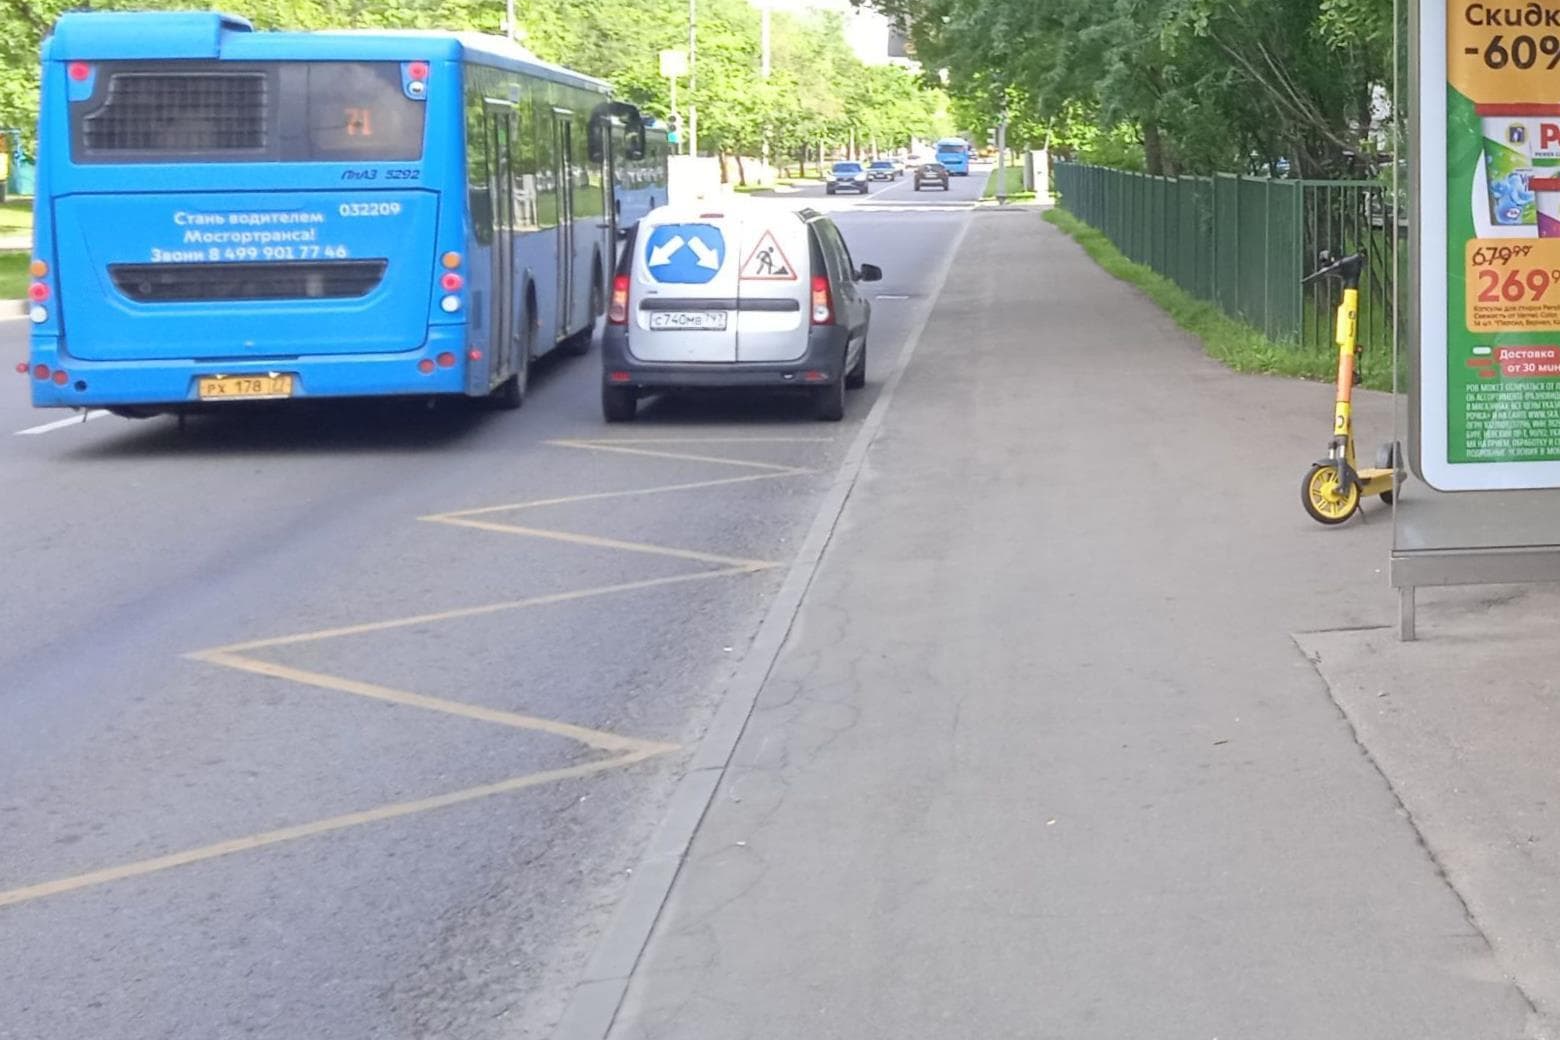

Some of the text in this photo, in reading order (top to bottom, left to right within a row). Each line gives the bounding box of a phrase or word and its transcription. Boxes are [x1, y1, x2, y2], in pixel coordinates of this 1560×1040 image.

[384, 169, 420, 180] 5292
[340, 202, 401, 217] 032209
[174, 211, 325, 227] Стань водителем
[183, 228, 316, 244] Мосгортранса!
[151, 245, 347, 261] Звони 8 499 901 77 46
[1478, 268, 1550, 302] 269
[1499, 349, 1555, 360] Доставка
[1507, 364, 1521, 373] от
[1521, 363, 1536, 372] 30
[234, 379, 262, 393] 178
